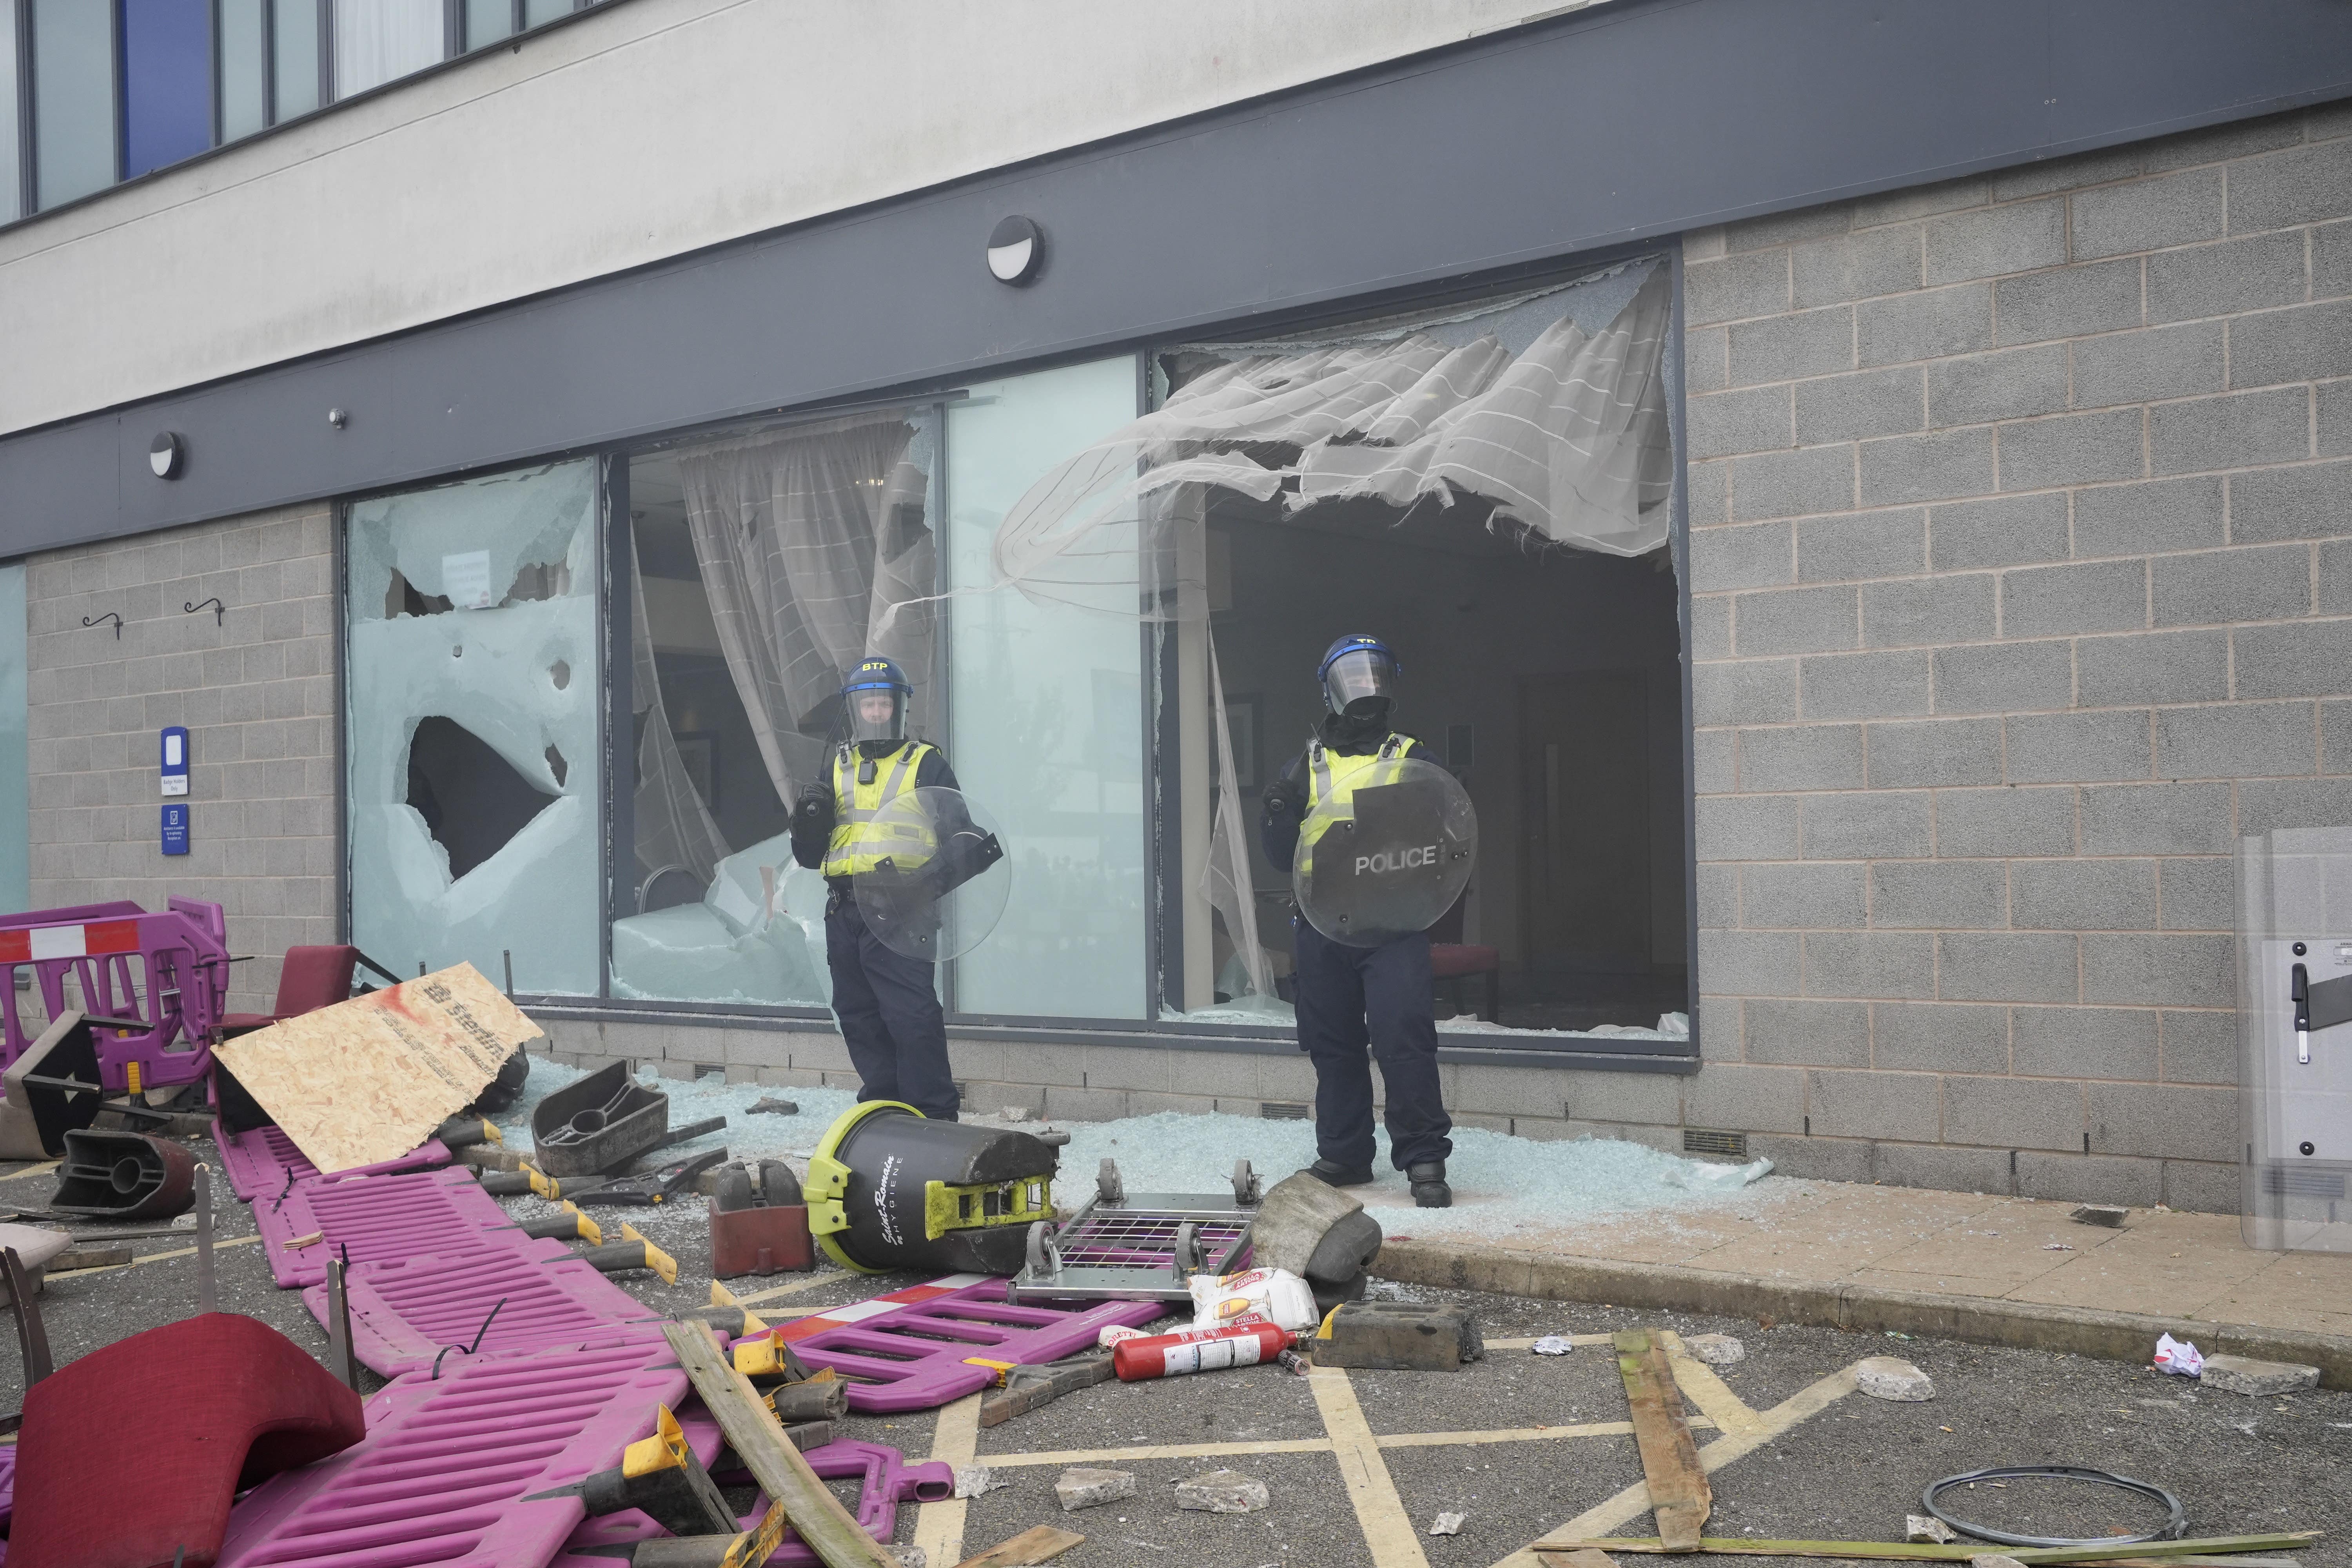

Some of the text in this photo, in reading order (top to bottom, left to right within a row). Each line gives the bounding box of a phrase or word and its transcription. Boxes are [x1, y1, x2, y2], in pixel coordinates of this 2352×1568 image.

[862, 662, 887, 671] BTP
[1355, 845, 1436, 876] POLICE
[875, 1155, 898, 1246] Saint-Romain
[889, 1157, 903, 1232] HYGIENE
[1236, 1272, 1260, 1285] STELLA
[1236, 1276, 1260, 1289] ARTOIS
[1236, 1315, 1259, 1324] STELLA
